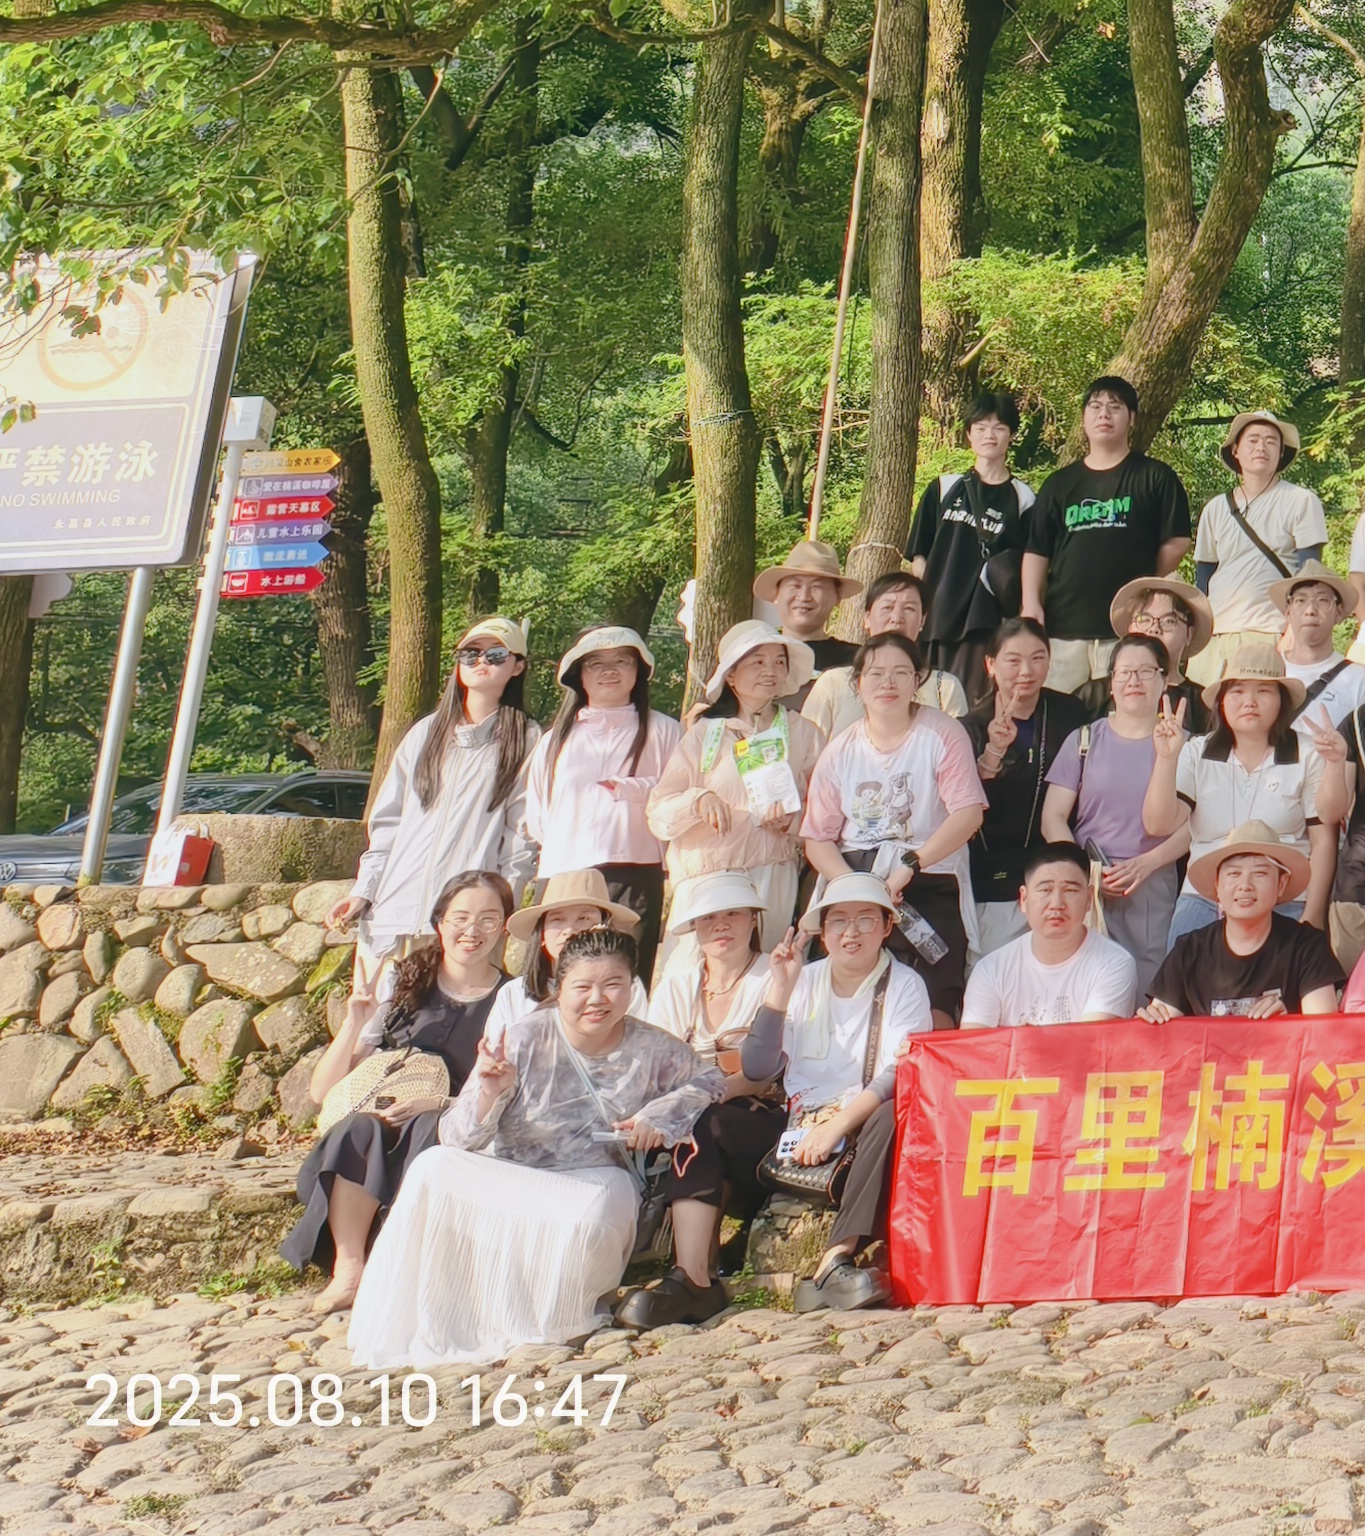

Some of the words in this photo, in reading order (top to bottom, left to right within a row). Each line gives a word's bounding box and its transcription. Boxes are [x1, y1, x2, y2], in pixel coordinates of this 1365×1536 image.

[0, 494, 26, 508] NO
[29, 489, 121, 507] SWIMMING
[1065, 496, 1132, 527] DREAM
[256, 524, 324, 539] 儿童水上乐园
[260, 573, 306, 586] 水上游船
